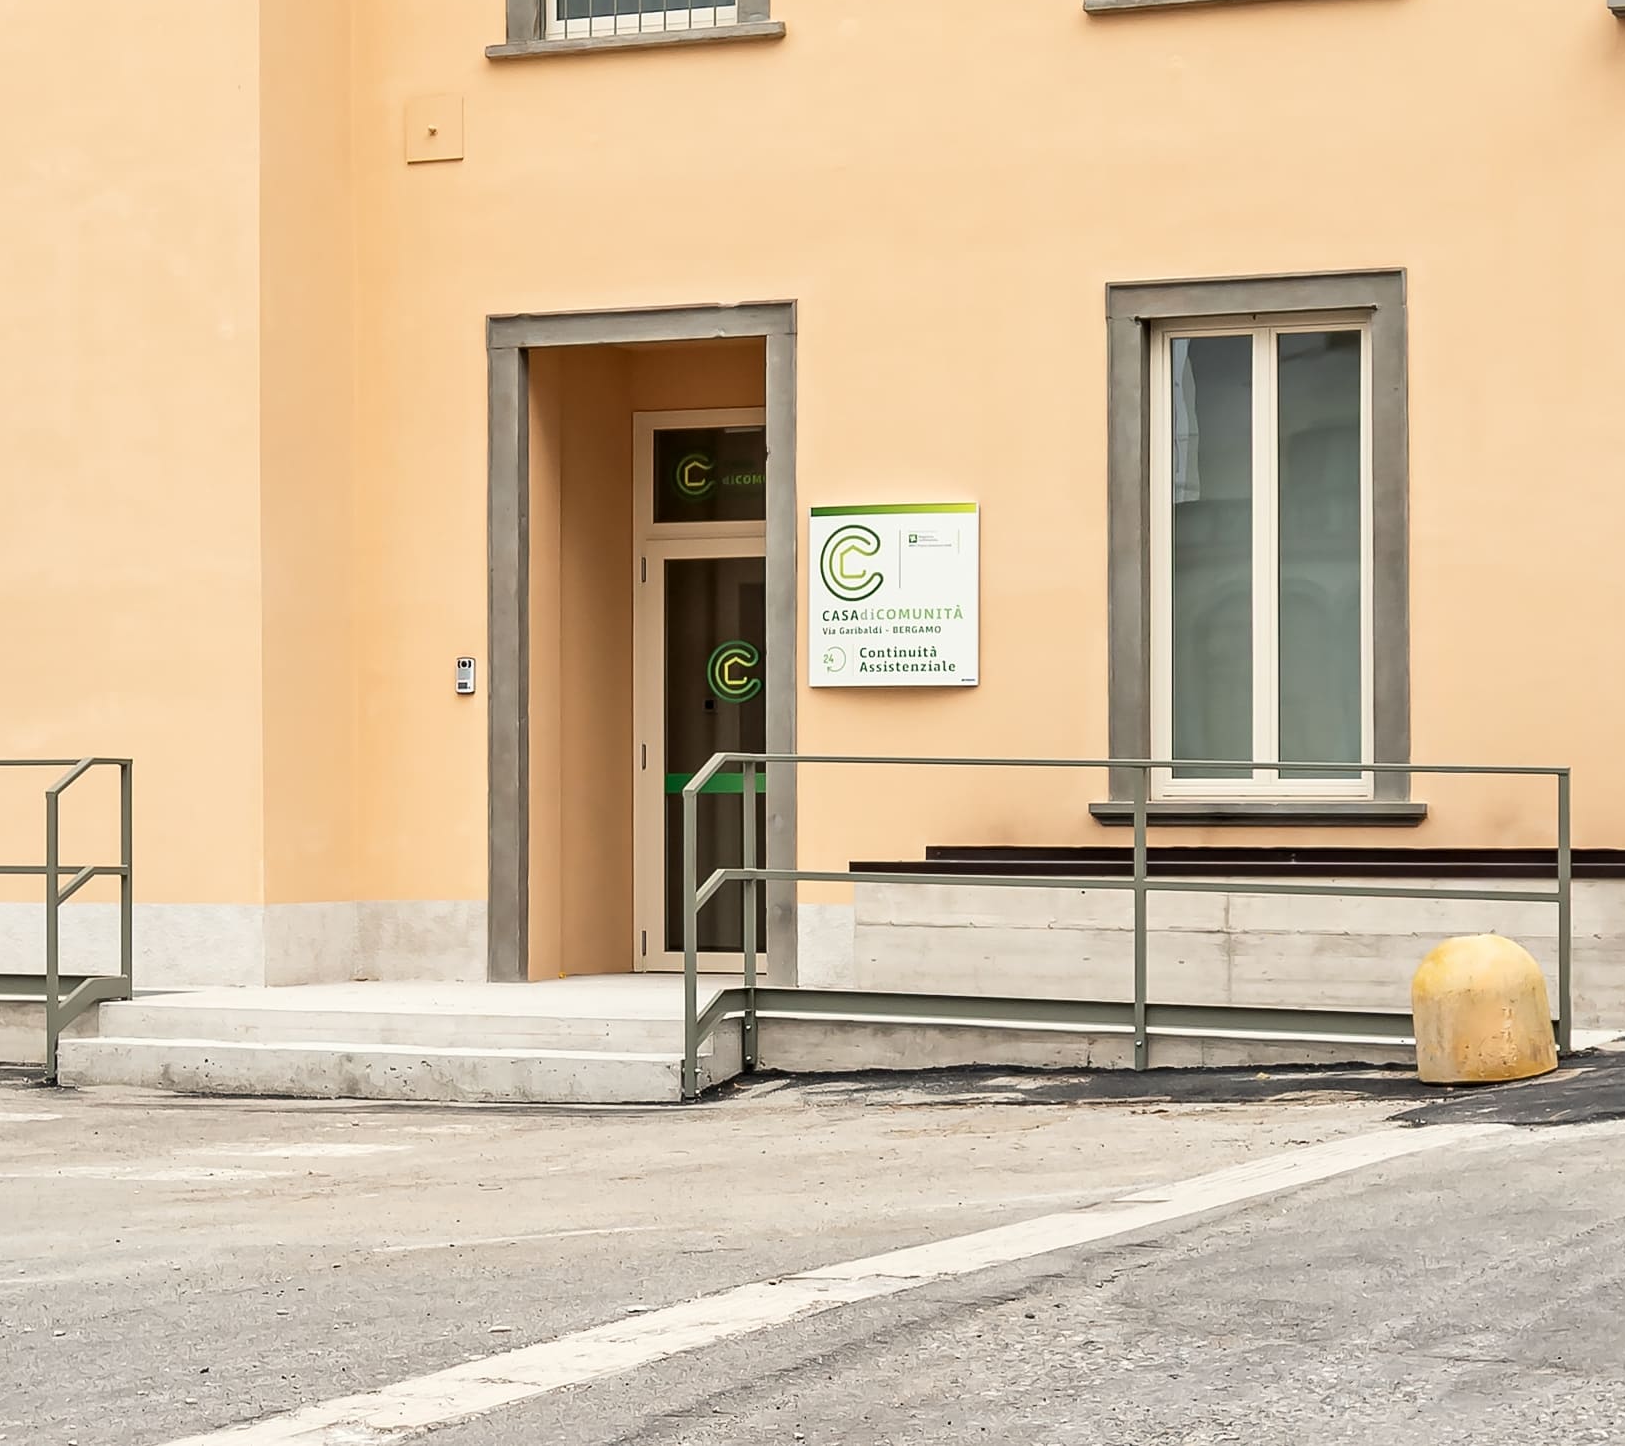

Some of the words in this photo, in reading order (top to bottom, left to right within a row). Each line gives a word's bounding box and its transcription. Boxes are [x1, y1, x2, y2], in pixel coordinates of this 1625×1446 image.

[822, 627, 836, 636] Via
[839, 626, 883, 636] Garibaldi
[892, 625, 942, 635] BERGAMO
[859, 646, 938, 659] Continuità
[823, 654, 835, 664] 24
[859, 661, 957, 673] Assistenziale
